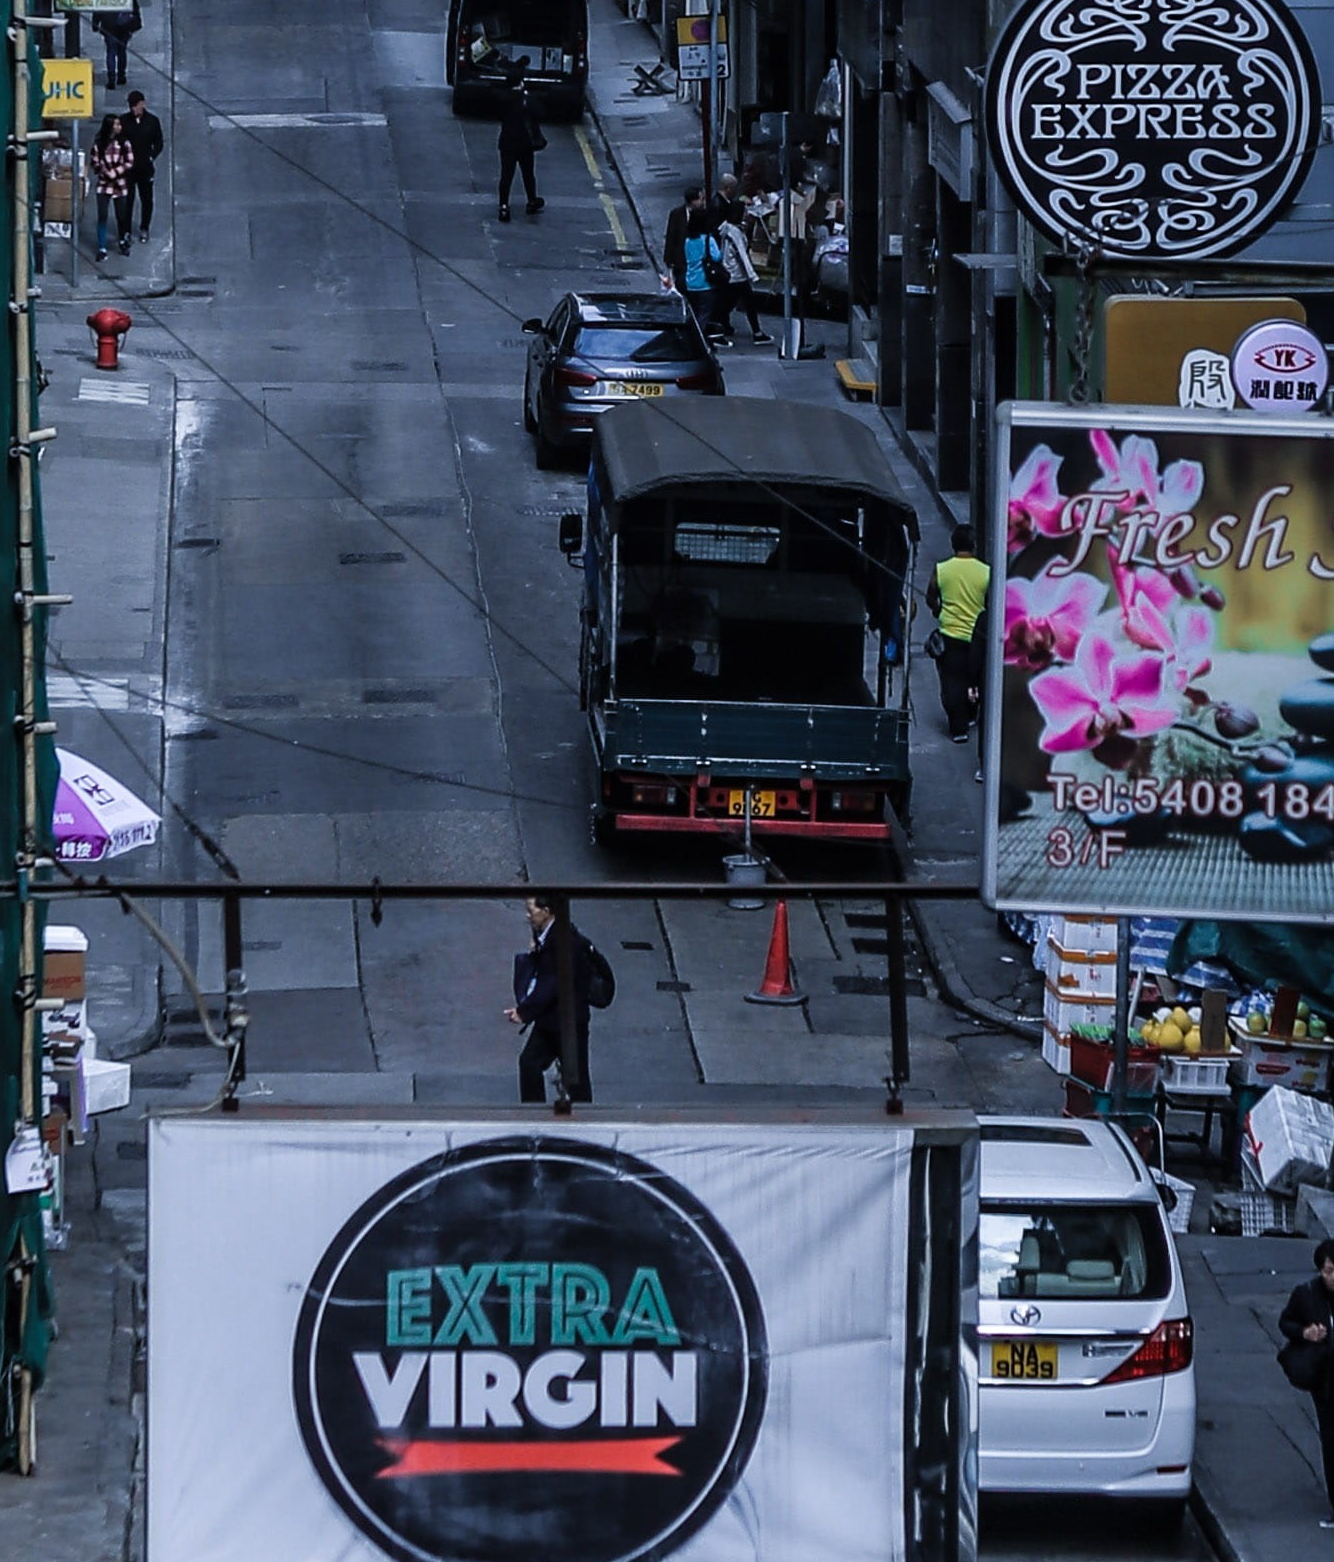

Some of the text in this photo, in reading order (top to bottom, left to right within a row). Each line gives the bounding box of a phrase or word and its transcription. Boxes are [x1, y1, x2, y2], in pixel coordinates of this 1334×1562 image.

[1076, 64, 1233, 100] PIZZA
[1030, 103, 1277, 140] EXPRESS
[1274, 349, 1297, 368] YK
[1045, 484, 1294, 579] Fresh
[732, 802, 772, 815] 967
[1045, 774, 1245, 818] Tel:5408
[1046, 827, 1128, 869] 3/F
[385, 1261, 681, 1348] EXTRA
[1010, 1345, 1038, 1364] NA
[352, 1350, 700, 1430] VIRGIN
